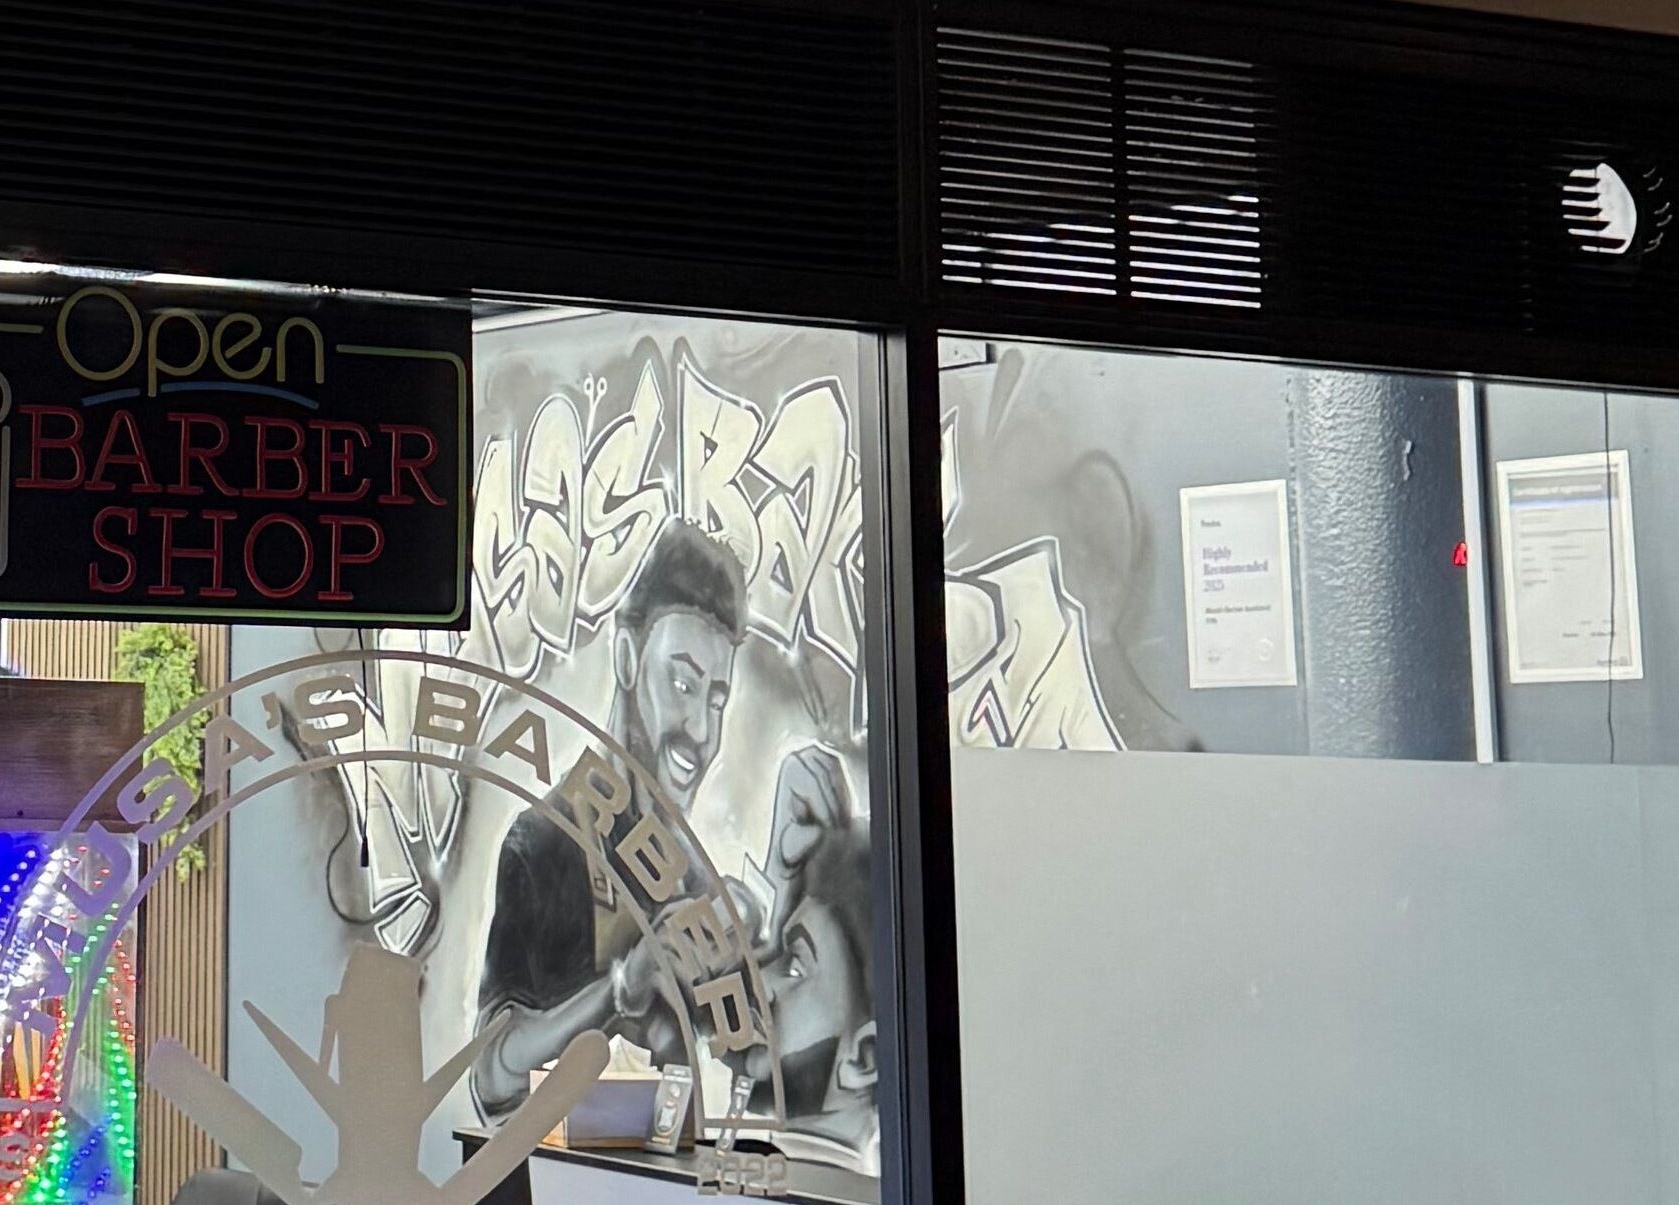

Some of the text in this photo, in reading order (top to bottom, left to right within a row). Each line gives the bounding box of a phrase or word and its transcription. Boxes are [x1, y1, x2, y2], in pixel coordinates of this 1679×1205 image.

[57, 286, 324, 397] Open
[15, 404, 448, 506] BARBER
[89, 506, 384, 601] SHOP
[412, 676, 767, 1056] BARBER
